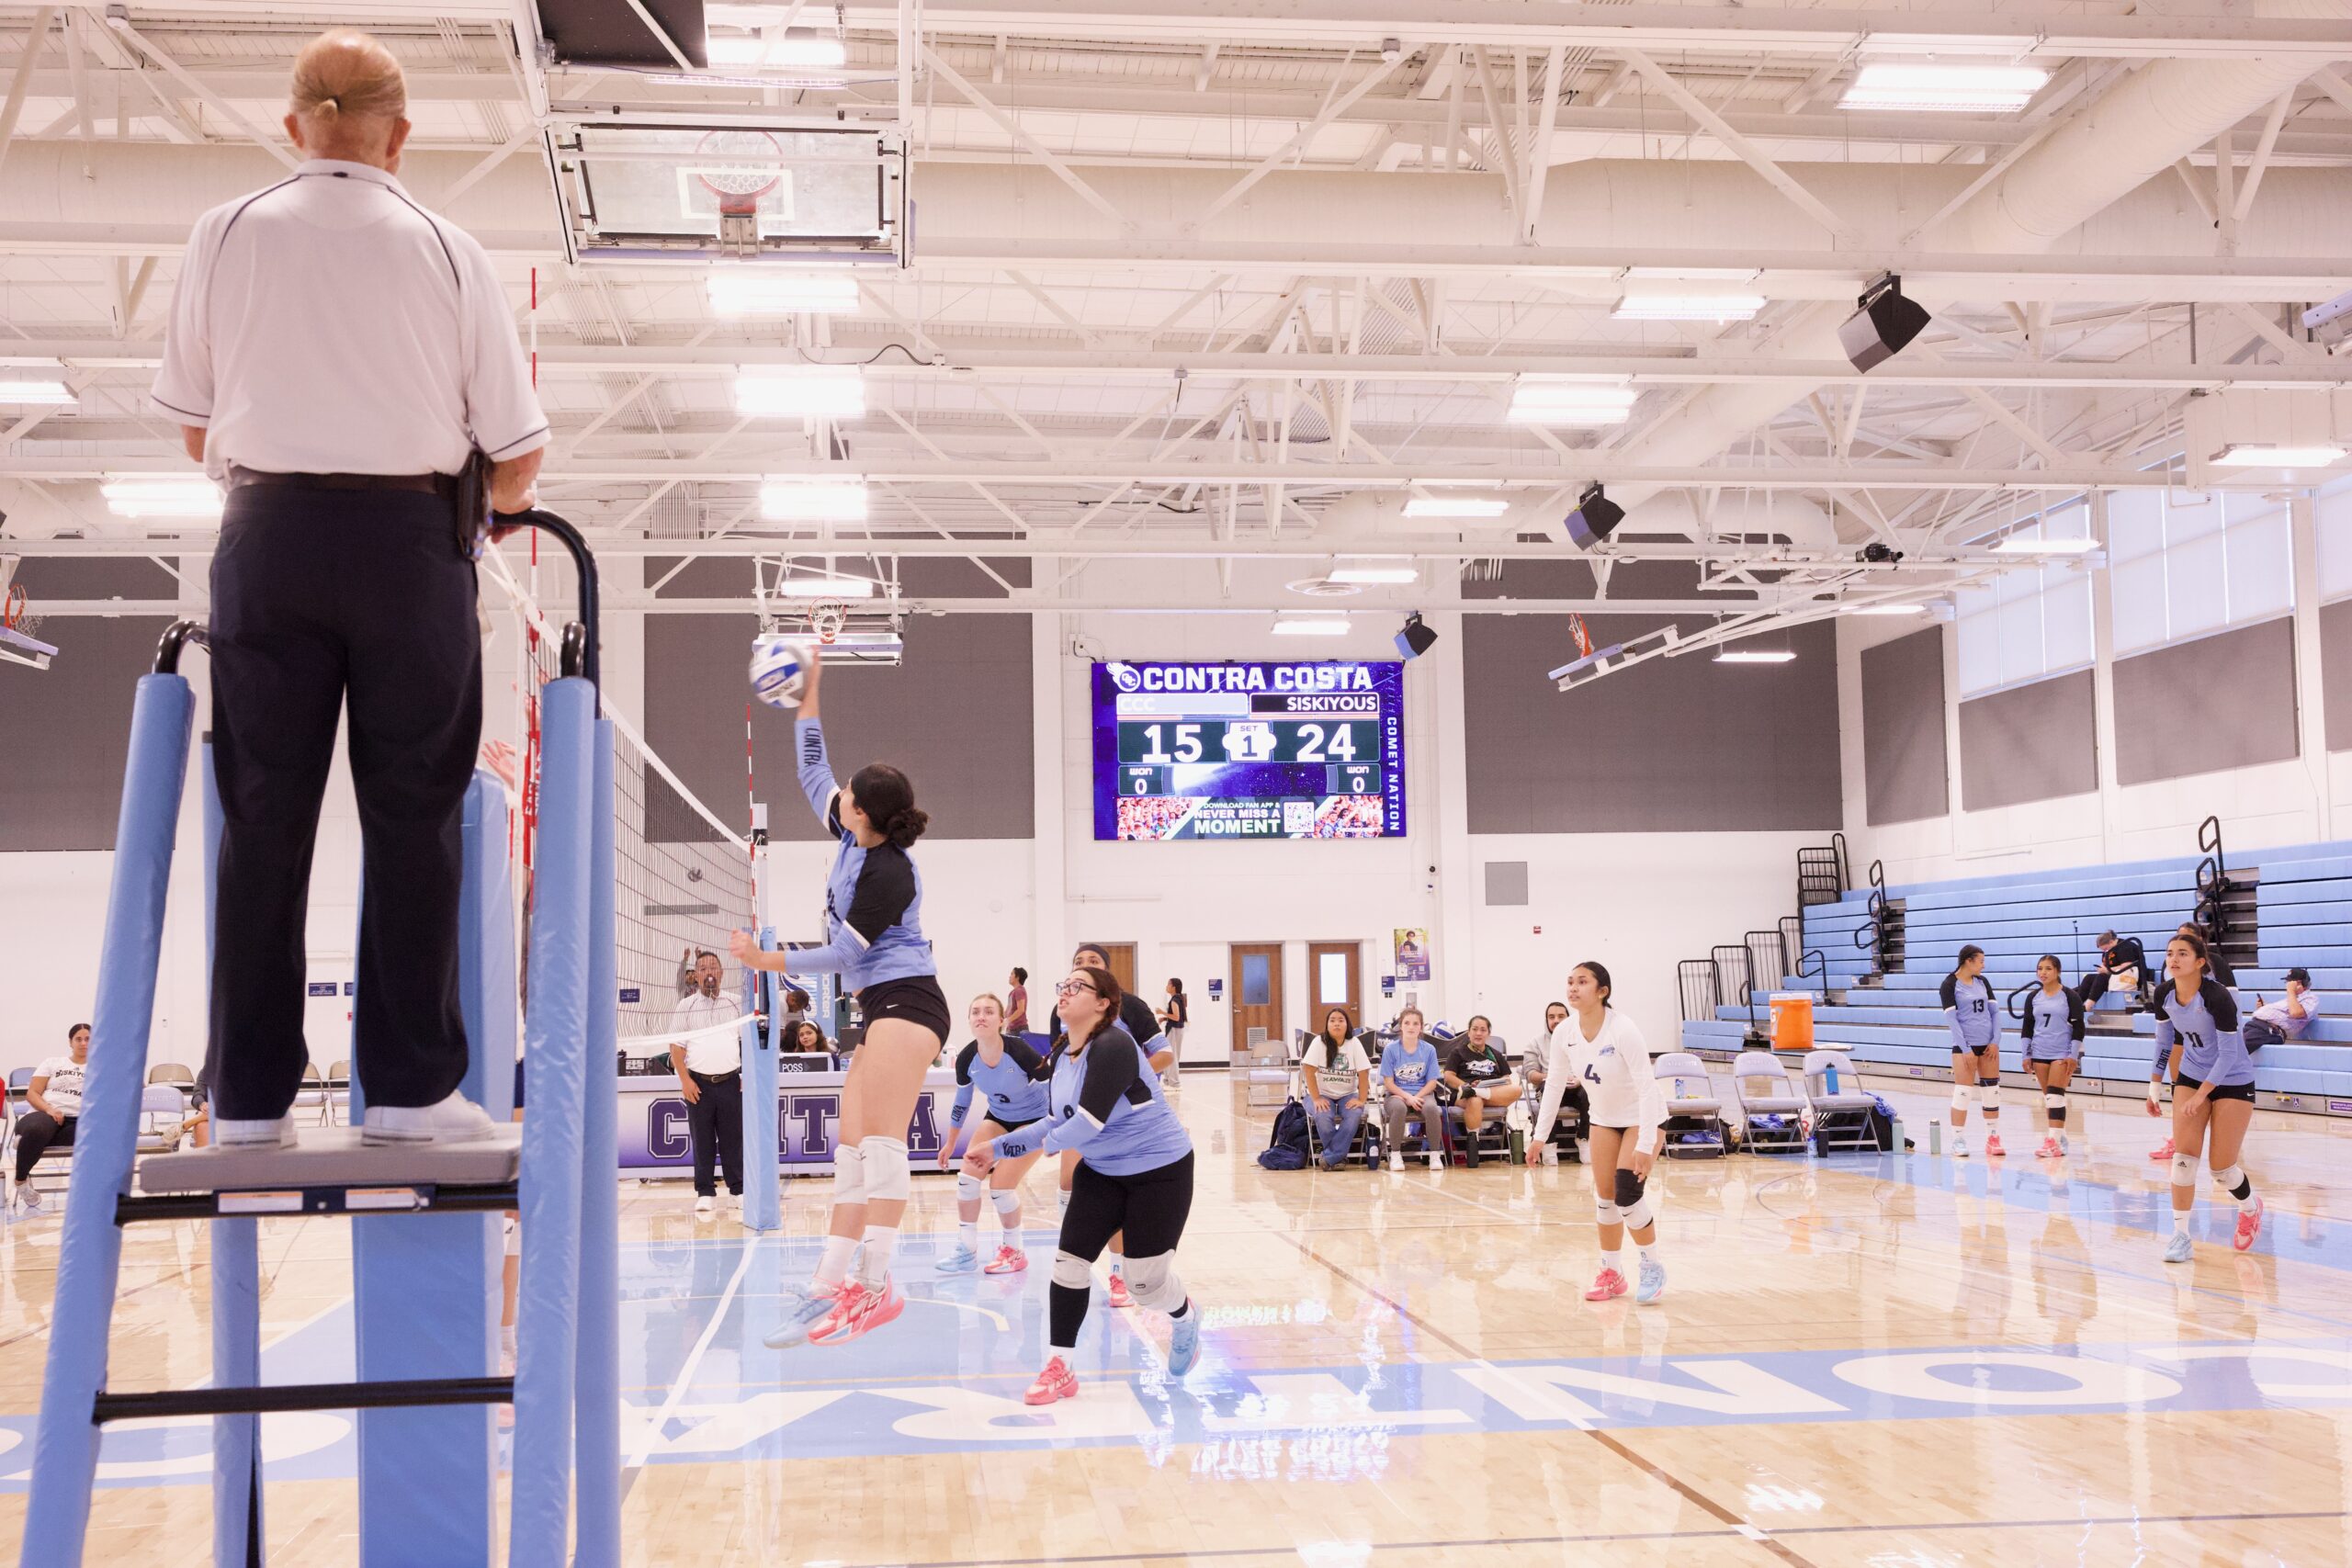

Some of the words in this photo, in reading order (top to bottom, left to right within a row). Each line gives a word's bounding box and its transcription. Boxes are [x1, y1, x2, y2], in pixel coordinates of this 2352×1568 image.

[1143, 667, 1266, 690] CONTRA
[1274, 666, 1374, 689] COSTA
[1120, 697, 1156, 712] CCC
[1287, 695, 1376, 711] SISKIYOUS
[1142, 724, 1203, 762] 15
[1242, 735, 1258, 757] 1
[1296, 723, 1356, 761] 24
[1387, 716, 1398, 768] COMET
[1135, 779, 1147, 795] 0
[1352, 777, 1364, 793] 0
[1388, 774, 1399, 830] NATION
[1194, 809, 1236, 818] NEVER
[1239, 809, 1269, 818] MISS
[1272, 809, 1281, 818] A
[1194, 819, 1280, 834] MOMENT
[1973, 999, 1984, 1013] 13
[2042, 1013, 2052, 1028] 7
[2185, 1032, 2204, 1048] 11
[782, 1064, 803, 1072] POSS
[1584, 1064, 1601, 1085] 4
